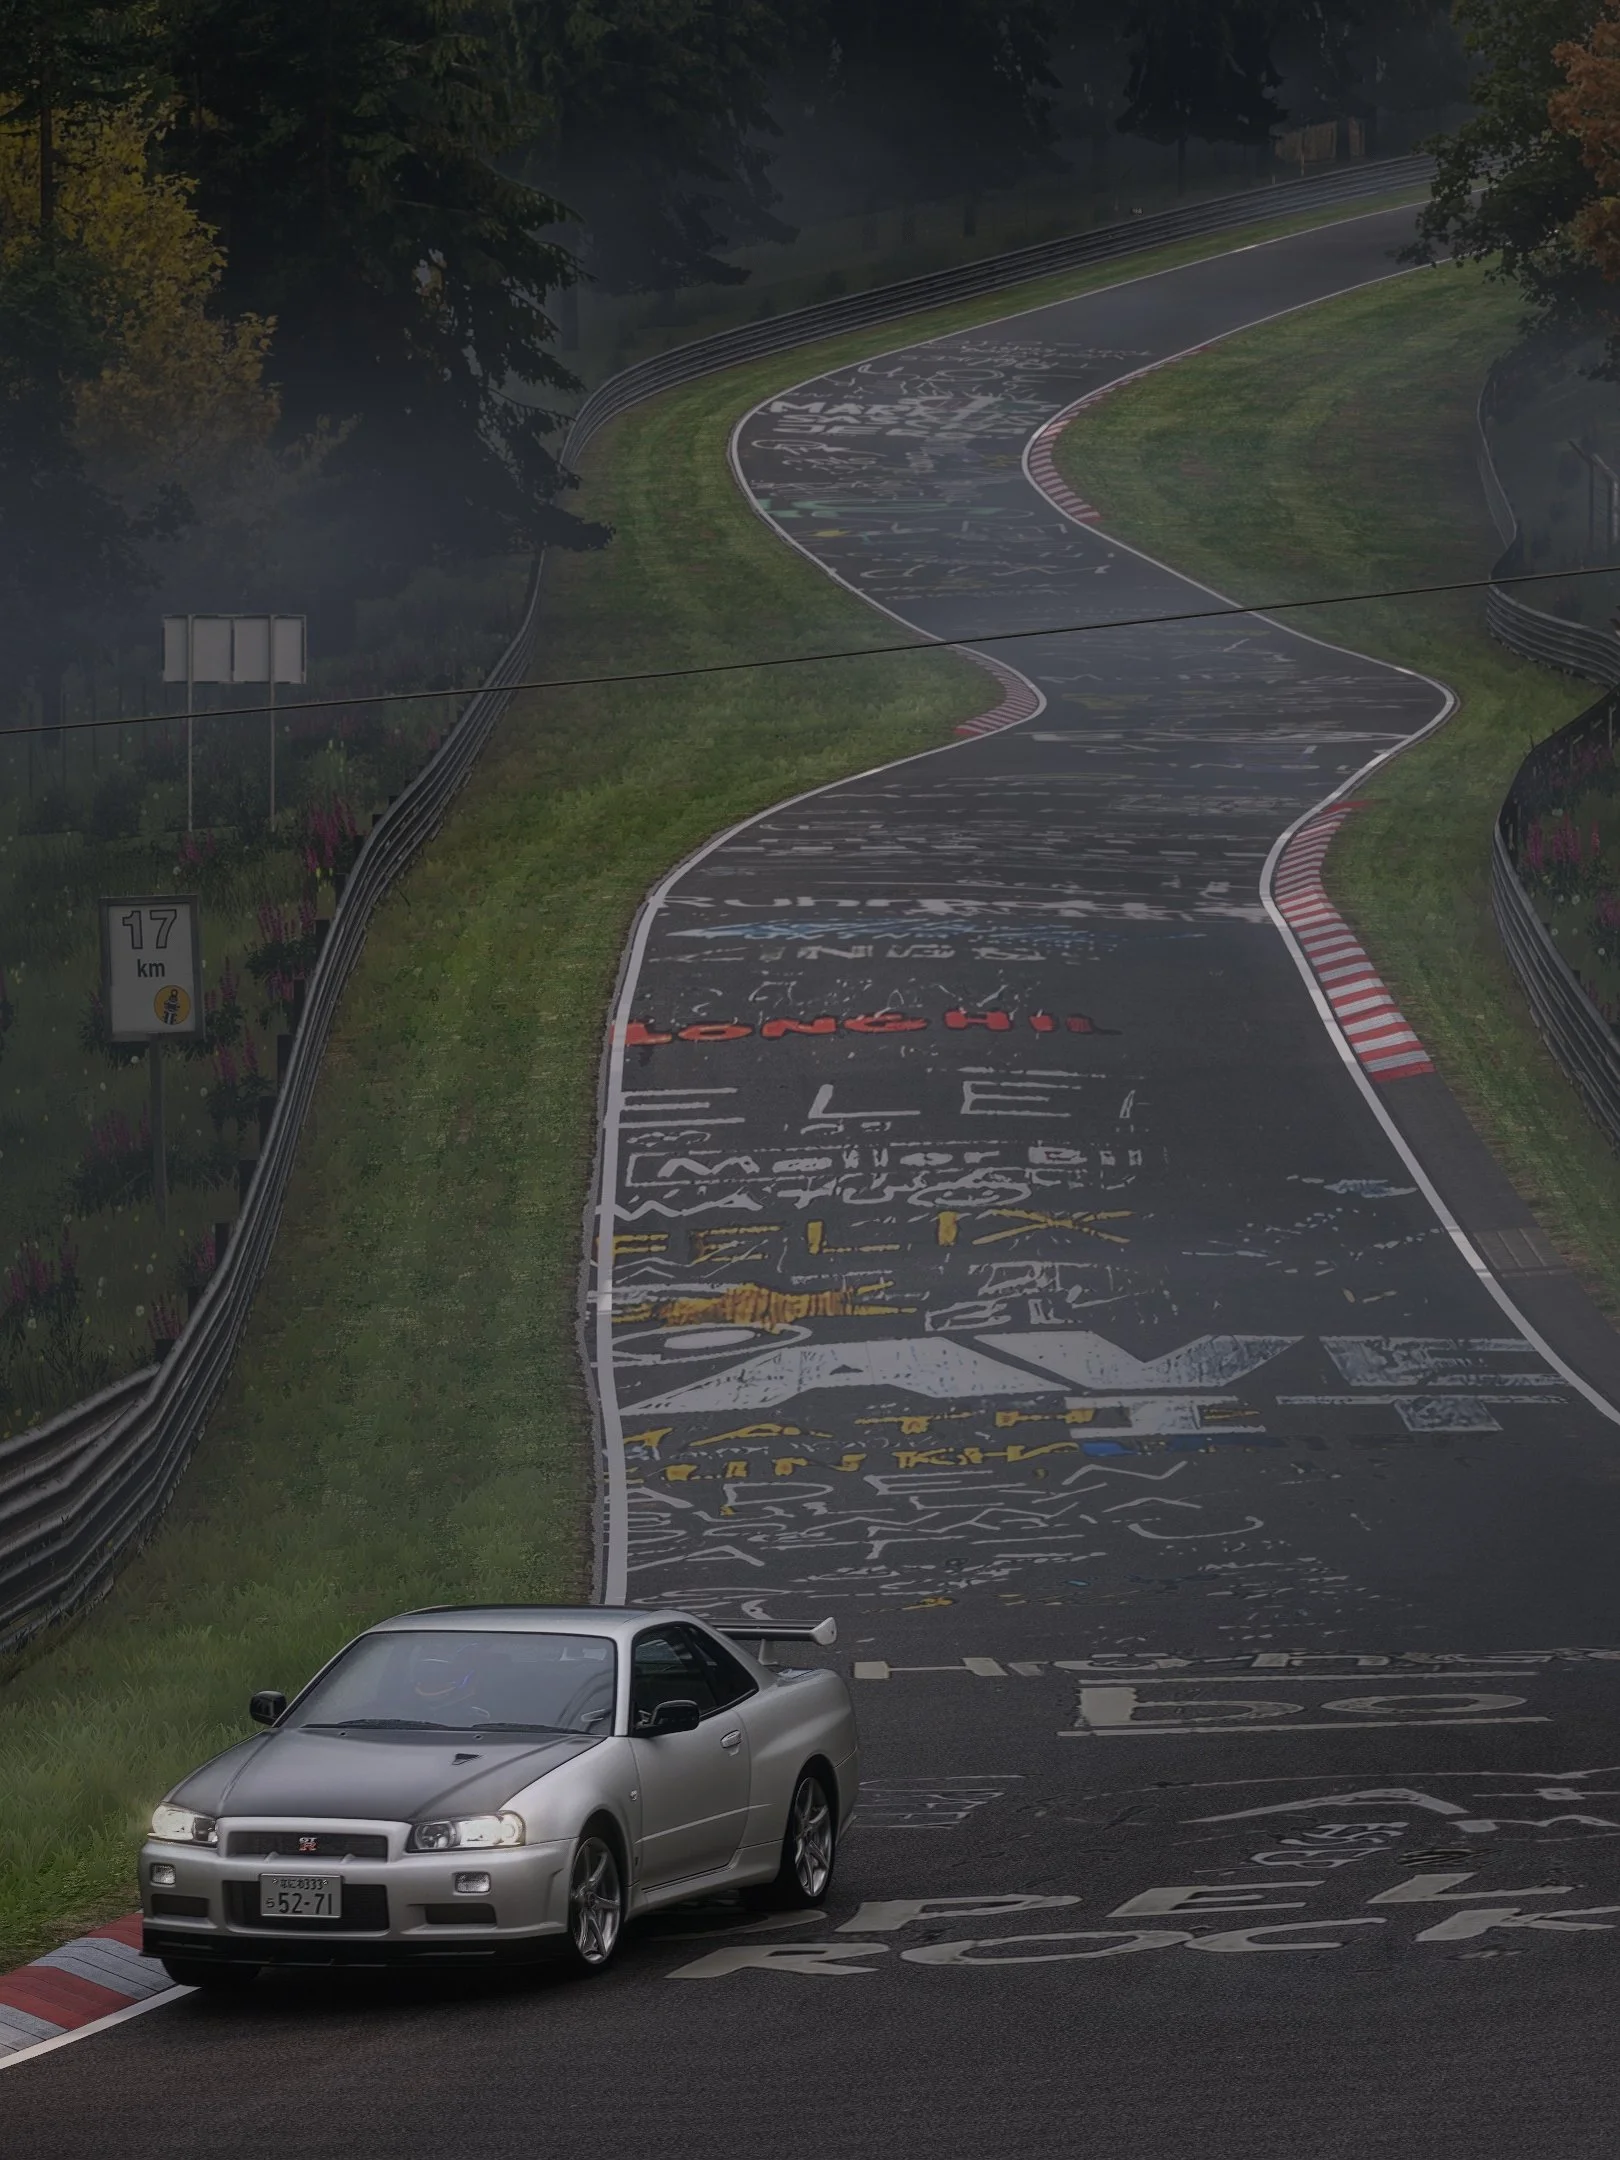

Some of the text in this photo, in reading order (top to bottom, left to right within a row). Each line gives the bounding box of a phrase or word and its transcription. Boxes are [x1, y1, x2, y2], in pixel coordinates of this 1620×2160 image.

[121, 908, 178, 950] 17
[137, 959, 166, 979] km
[598, 1210, 1132, 1263] FELIX
[278, 1892, 332, 1915] 52-71
